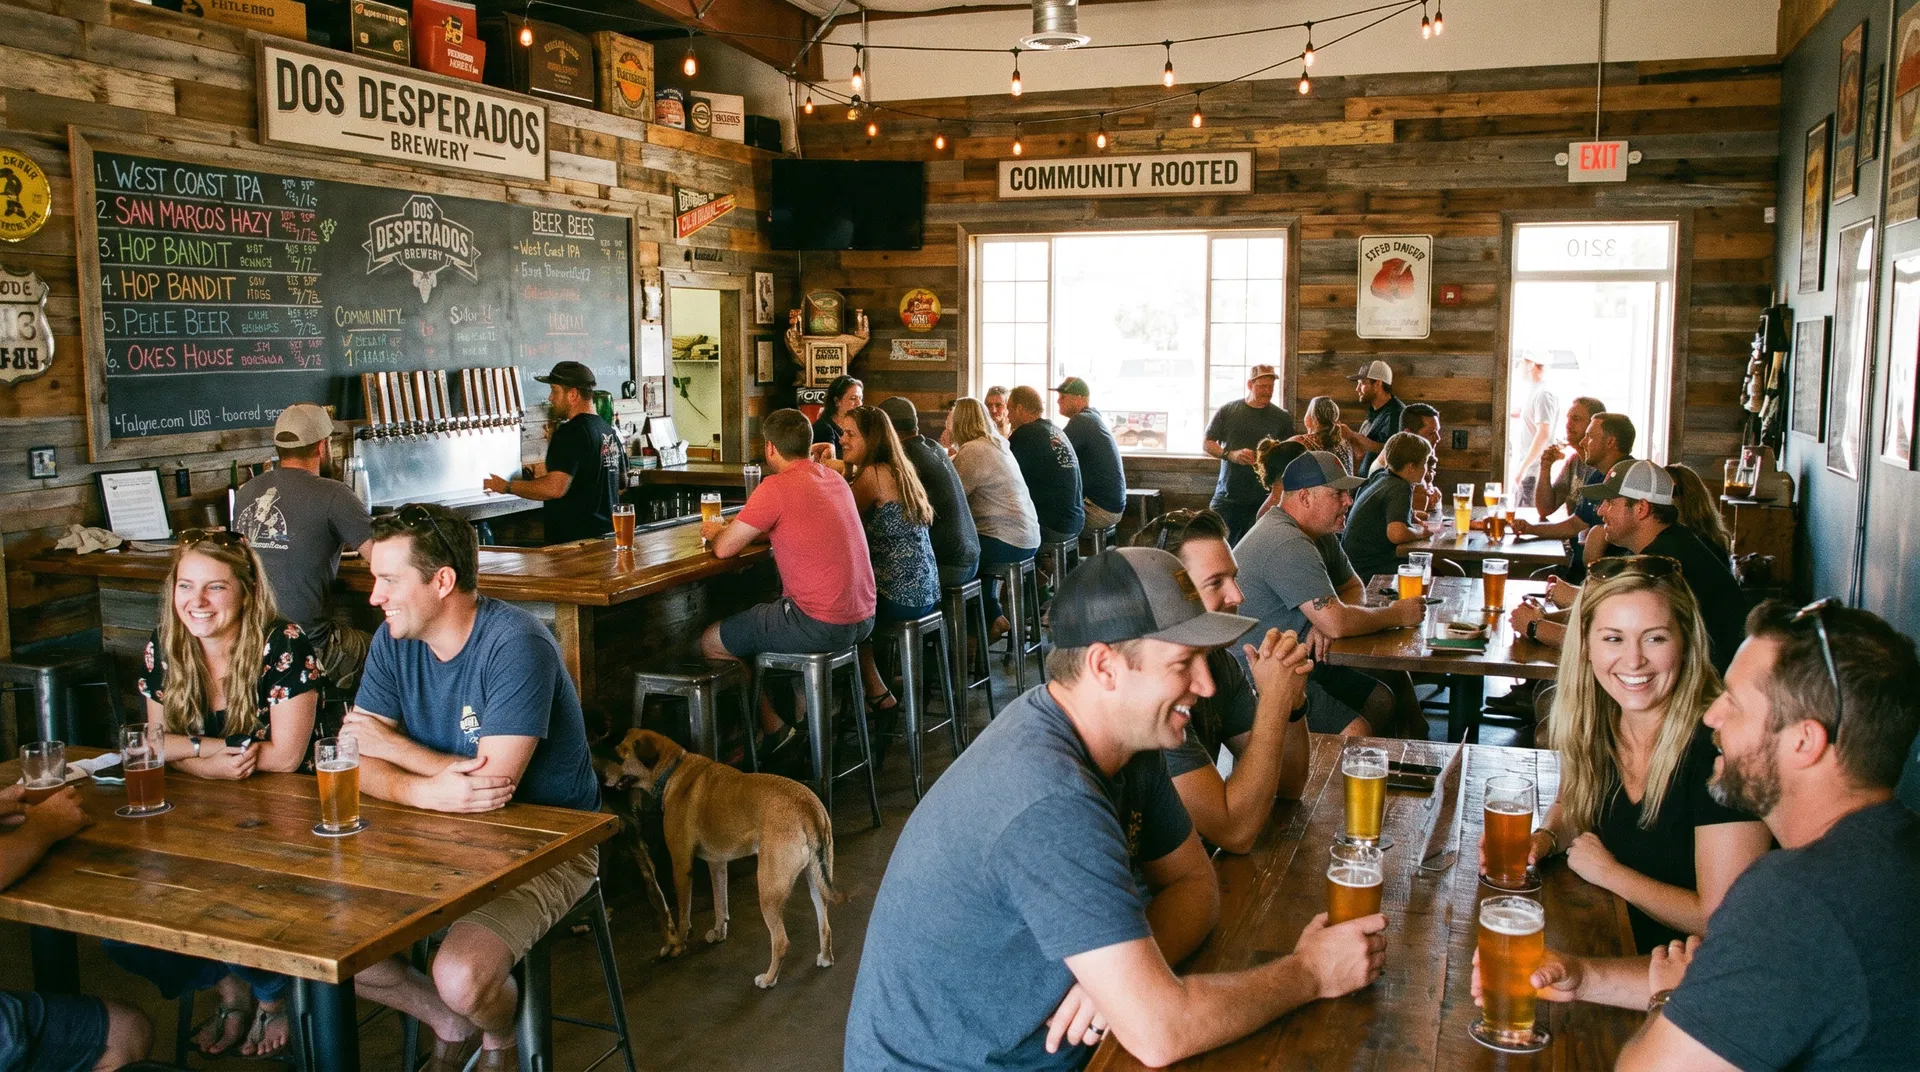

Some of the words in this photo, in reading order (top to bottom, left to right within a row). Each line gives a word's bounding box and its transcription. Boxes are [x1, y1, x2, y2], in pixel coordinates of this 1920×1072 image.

[276, 57, 345, 116] DOS
[358, 75, 540, 155] DESPERADOS
[391, 131, 469, 162] BREWERY
[1579, 144, 1620, 170] EXIT
[112, 160, 167, 193] WEST
[173, 168, 227, 198] COAST
[233, 174, 264, 203] IPA
[1010, 163, 1142, 191] COMMUNITY
[1151, 160, 1239, 187] ROOTED
[115, 196, 155, 226] SAN
[159, 200, 226, 233] MARCOS
[231, 208, 272, 238] HAZY
[412, 202, 433, 219] DOS
[532, 210, 563, 234] BEER
[568, 214, 595, 236] BEES
[118, 233, 156, 263] HOP
[163, 236, 233, 268] BANDIT
[376, 220, 468, 257] DESPERADOS
[404, 248, 443, 261] BREWERY
[121, 270, 160, 300] HOP
[167, 272, 236, 301] BANDIT
[184, 308, 234, 336] BEER
[127, 345, 177, 371] OKES
[184, 344, 234, 369] HOUSE
